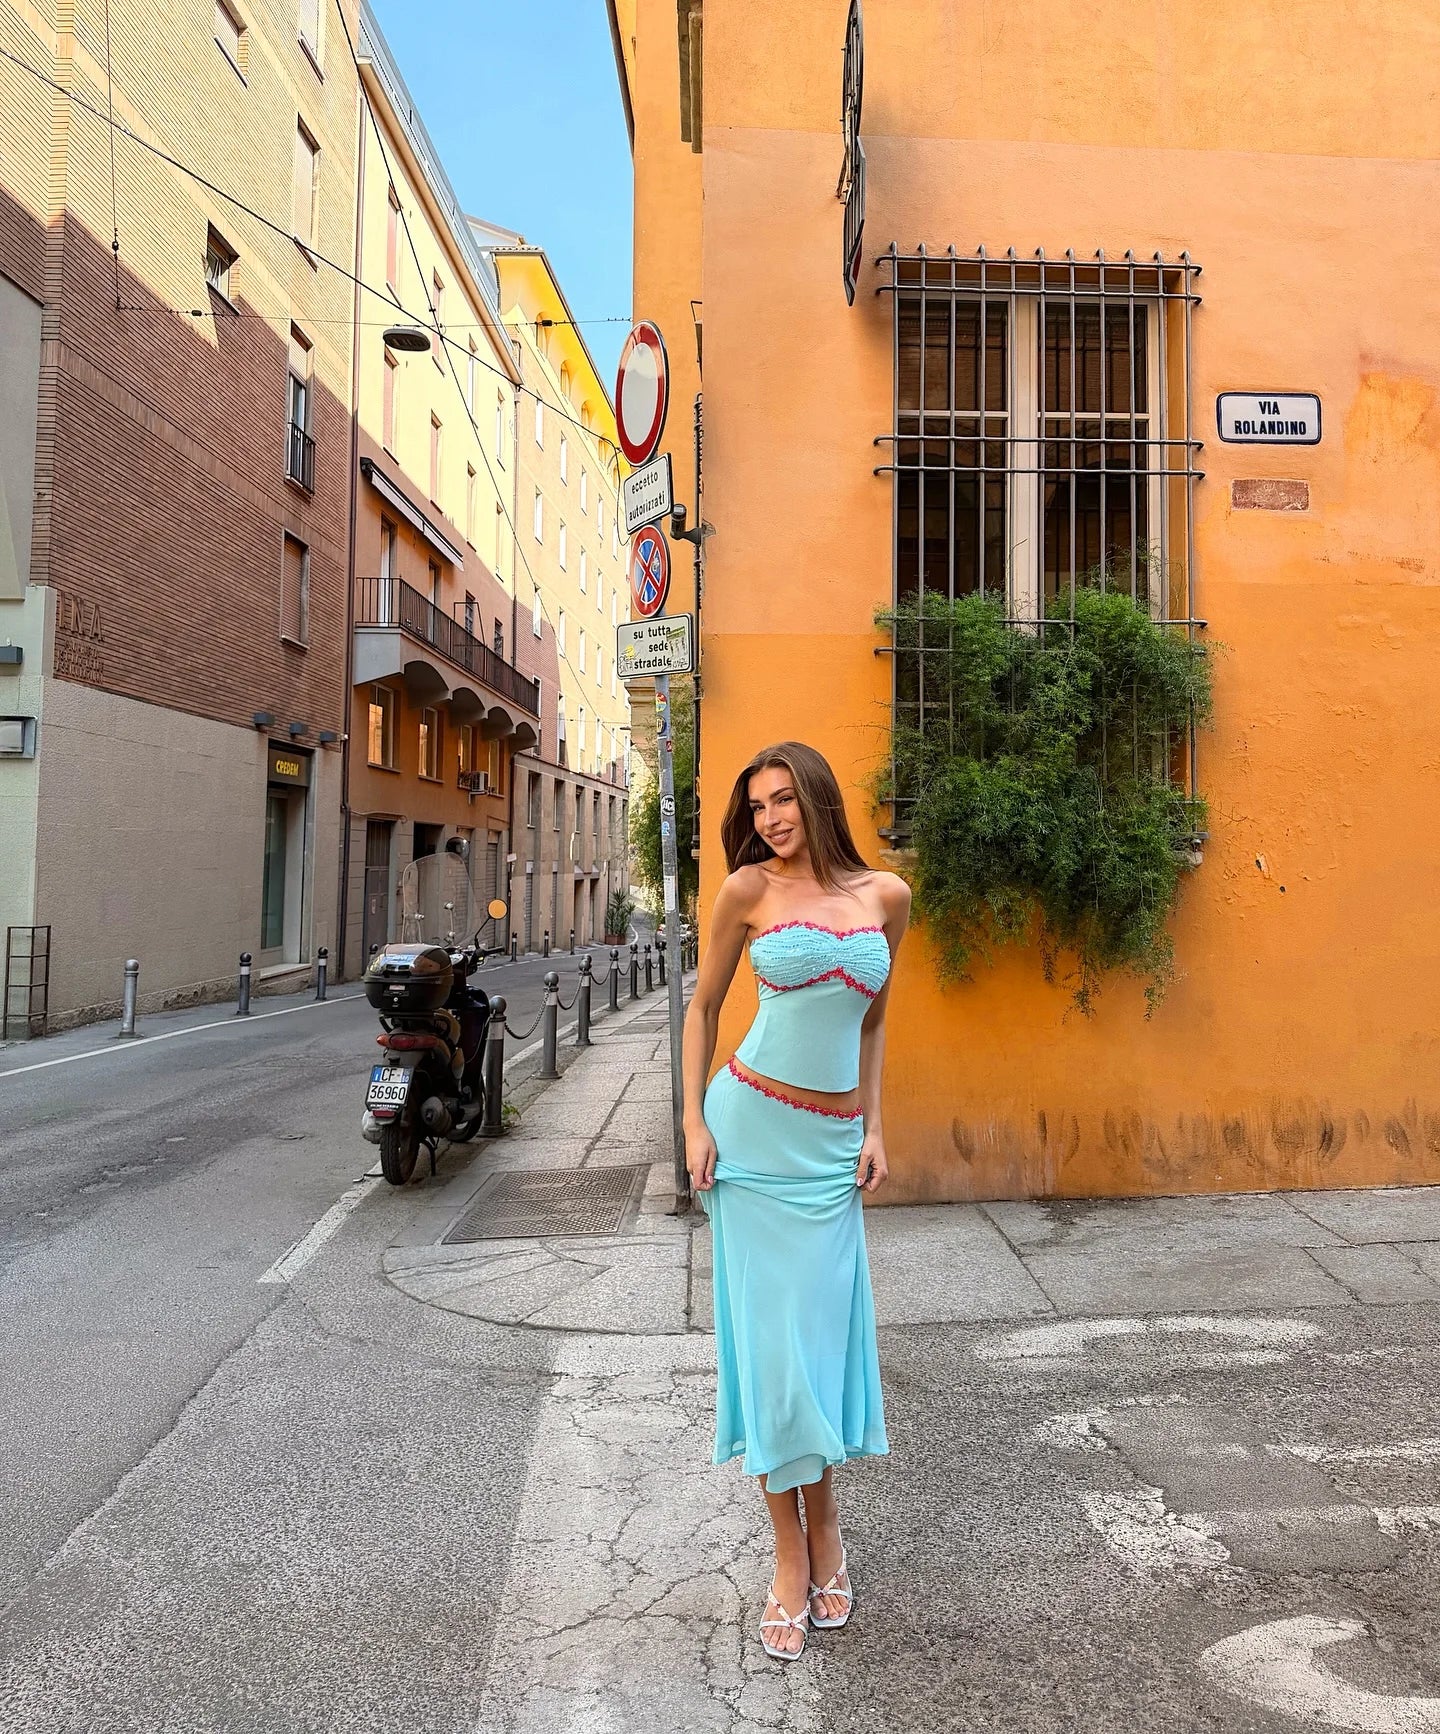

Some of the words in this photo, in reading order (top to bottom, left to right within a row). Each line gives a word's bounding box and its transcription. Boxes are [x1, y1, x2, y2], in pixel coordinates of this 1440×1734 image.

[1258, 401, 1280, 415] VIA
[1234, 420, 1307, 435] ROLANDINO
[631, 471, 659, 495] eccetto
[629, 490, 665, 521] autorizzati
[633, 630, 644, 640] su
[648, 624, 671, 638] tutta
[648, 639, 669, 653] sede
[634, 655, 672, 670] stradale
[276, 759, 299, 777] CREDEM
[370, 1085, 406, 1100] 36960
